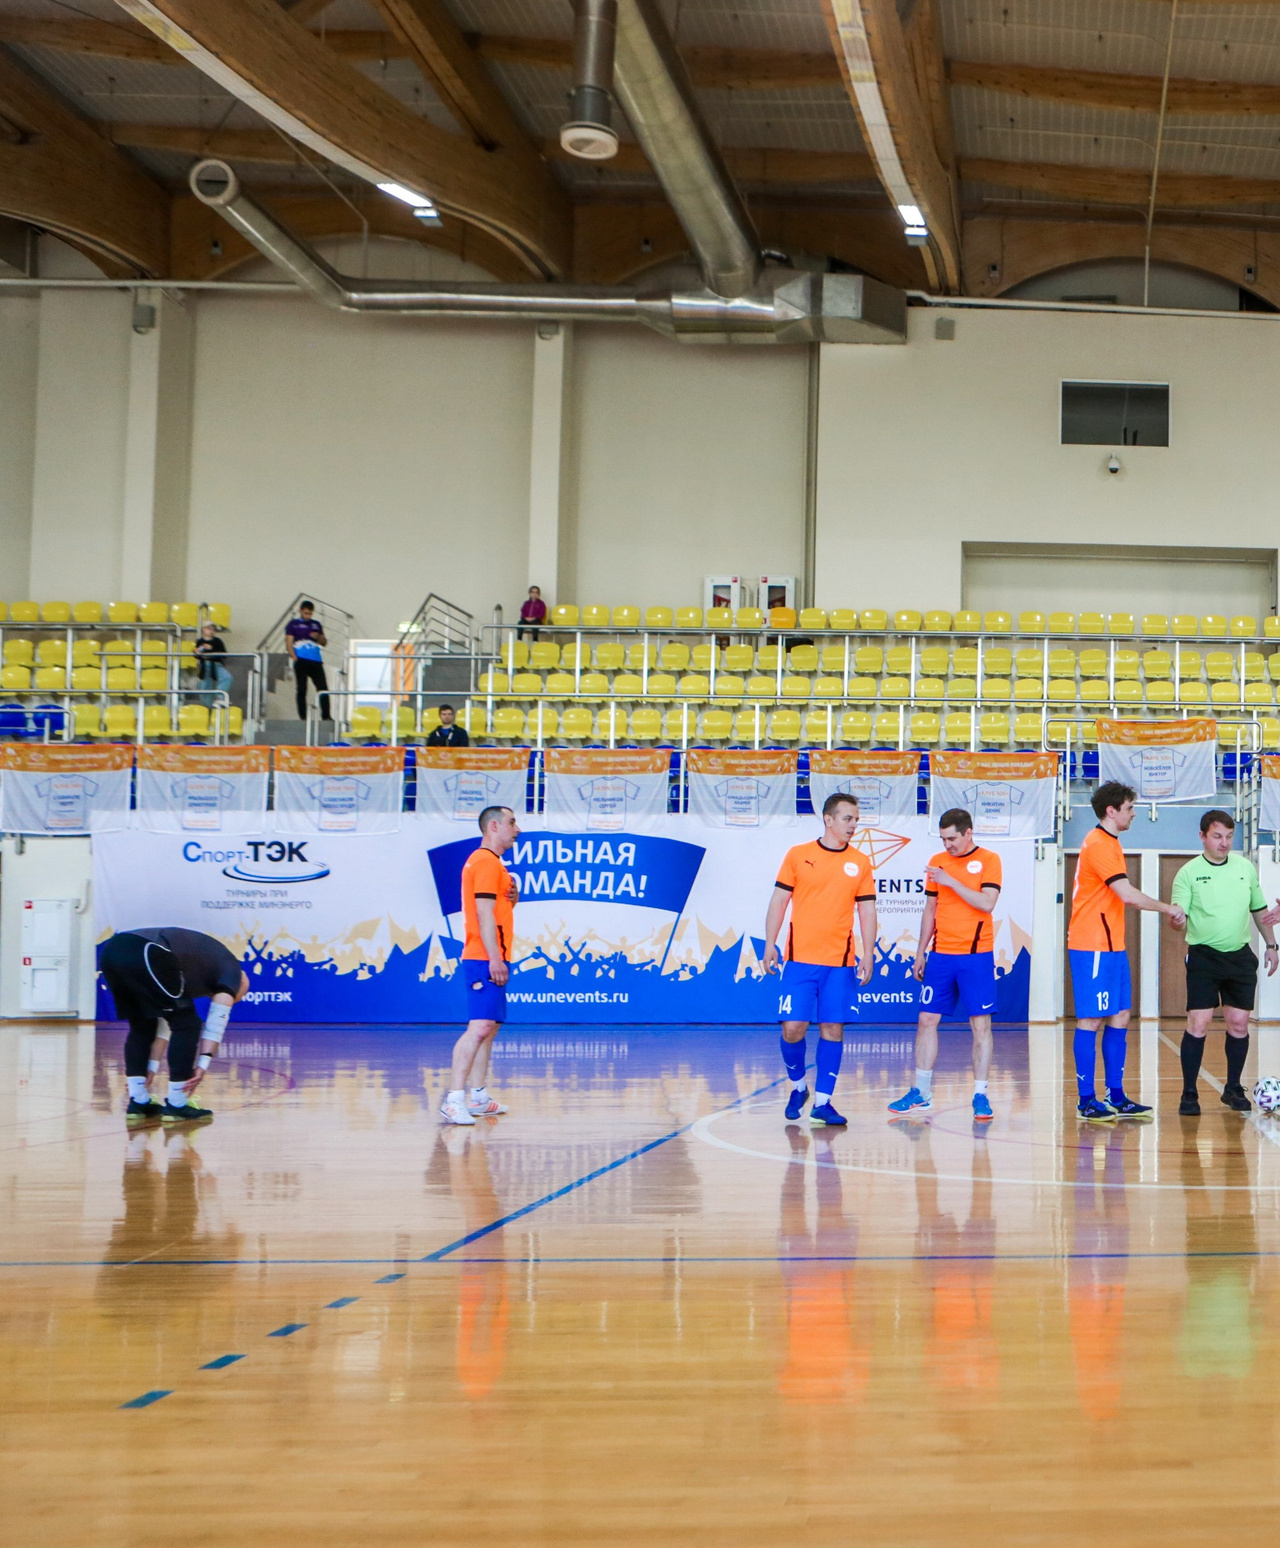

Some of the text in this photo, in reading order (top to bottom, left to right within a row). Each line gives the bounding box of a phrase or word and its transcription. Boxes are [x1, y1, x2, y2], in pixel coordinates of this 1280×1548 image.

[508, 870, 647, 899] ОМАНДА!
[200, 901, 312, 909] ПОДДЕРЖКЕ МИНЭНЕРГО
[242, 992, 292, 1005] орттэк
[506, 991, 628, 1003] ww.unevents.ru
[779, 995, 792, 1014] 14
[1097, 992, 1109, 1011] 13
